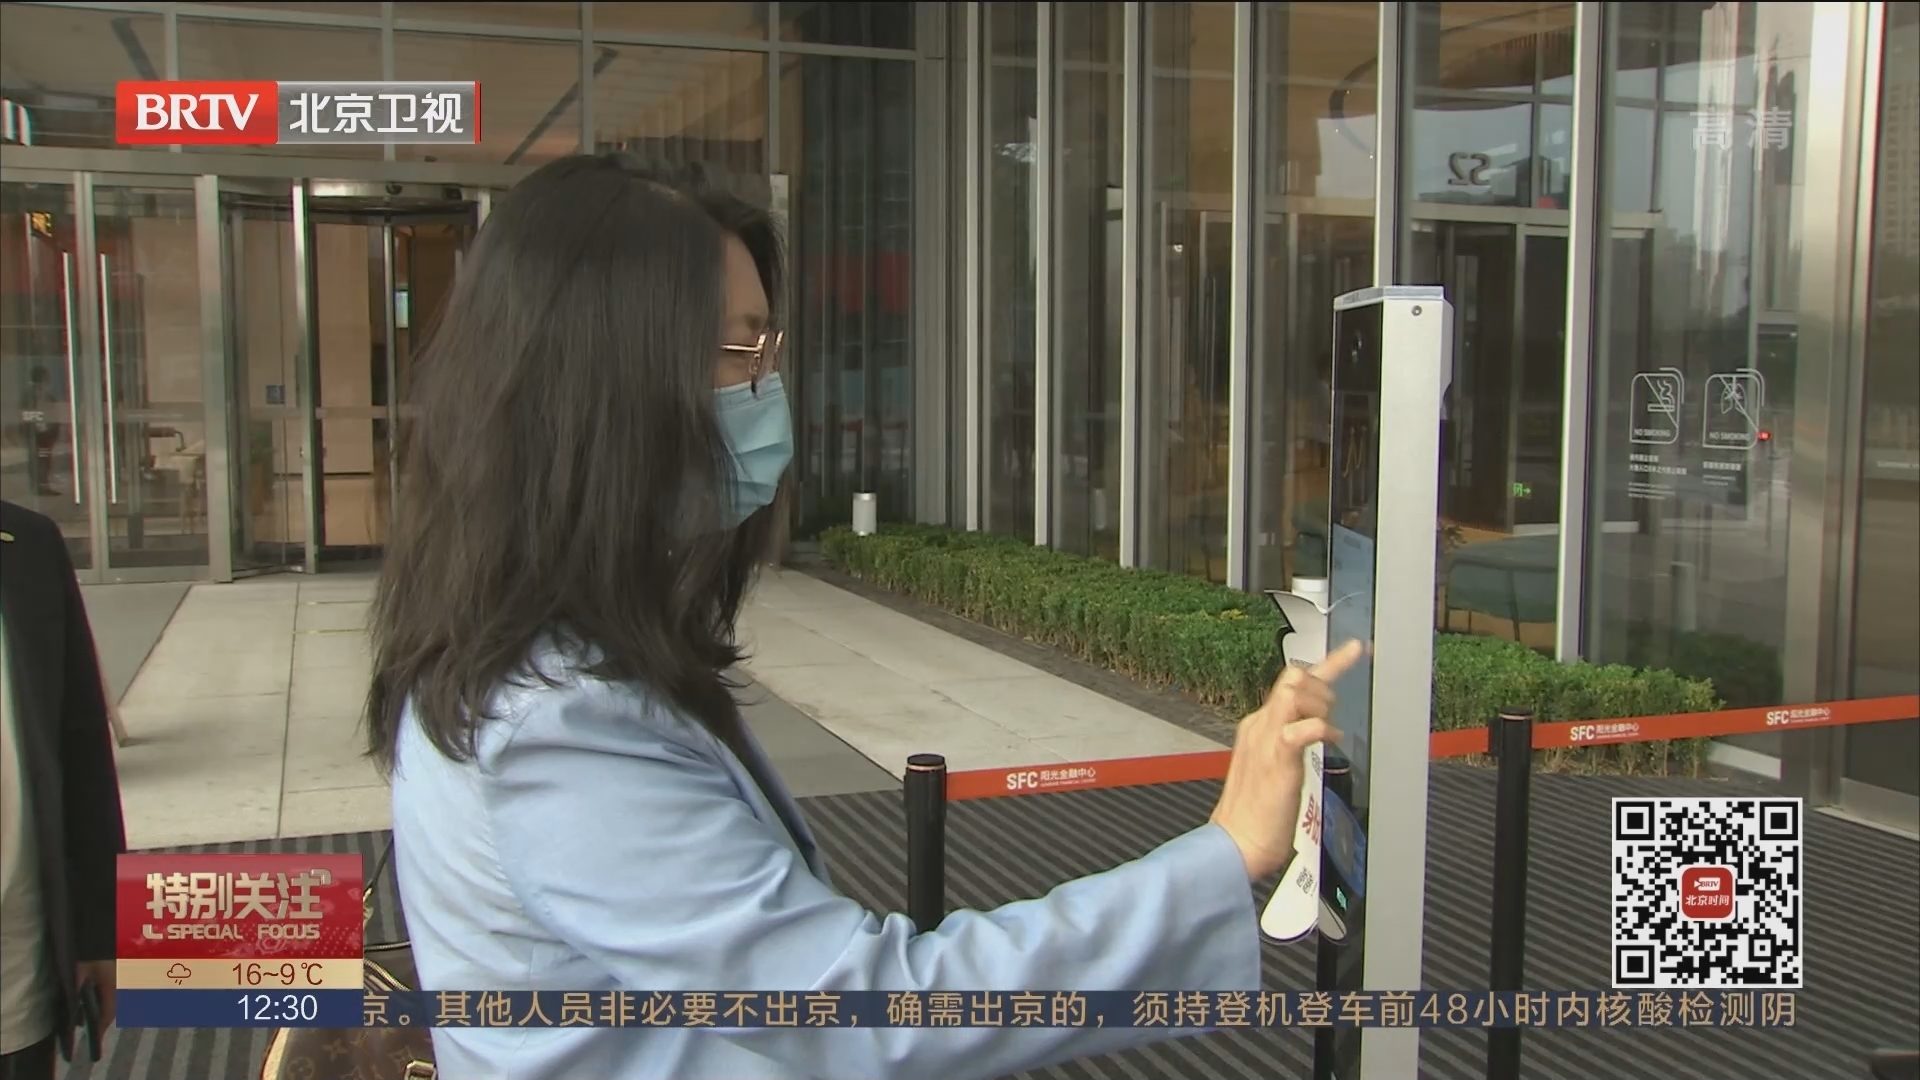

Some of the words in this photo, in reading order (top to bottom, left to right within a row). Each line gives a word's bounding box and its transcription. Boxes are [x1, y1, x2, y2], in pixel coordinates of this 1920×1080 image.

[1767, 710, 1789, 725] SFC
[1570, 725, 1595, 741] SFC
[1006, 771, 1038, 790] SFC
[1040, 767, 1096, 781] 阳光金融中心
